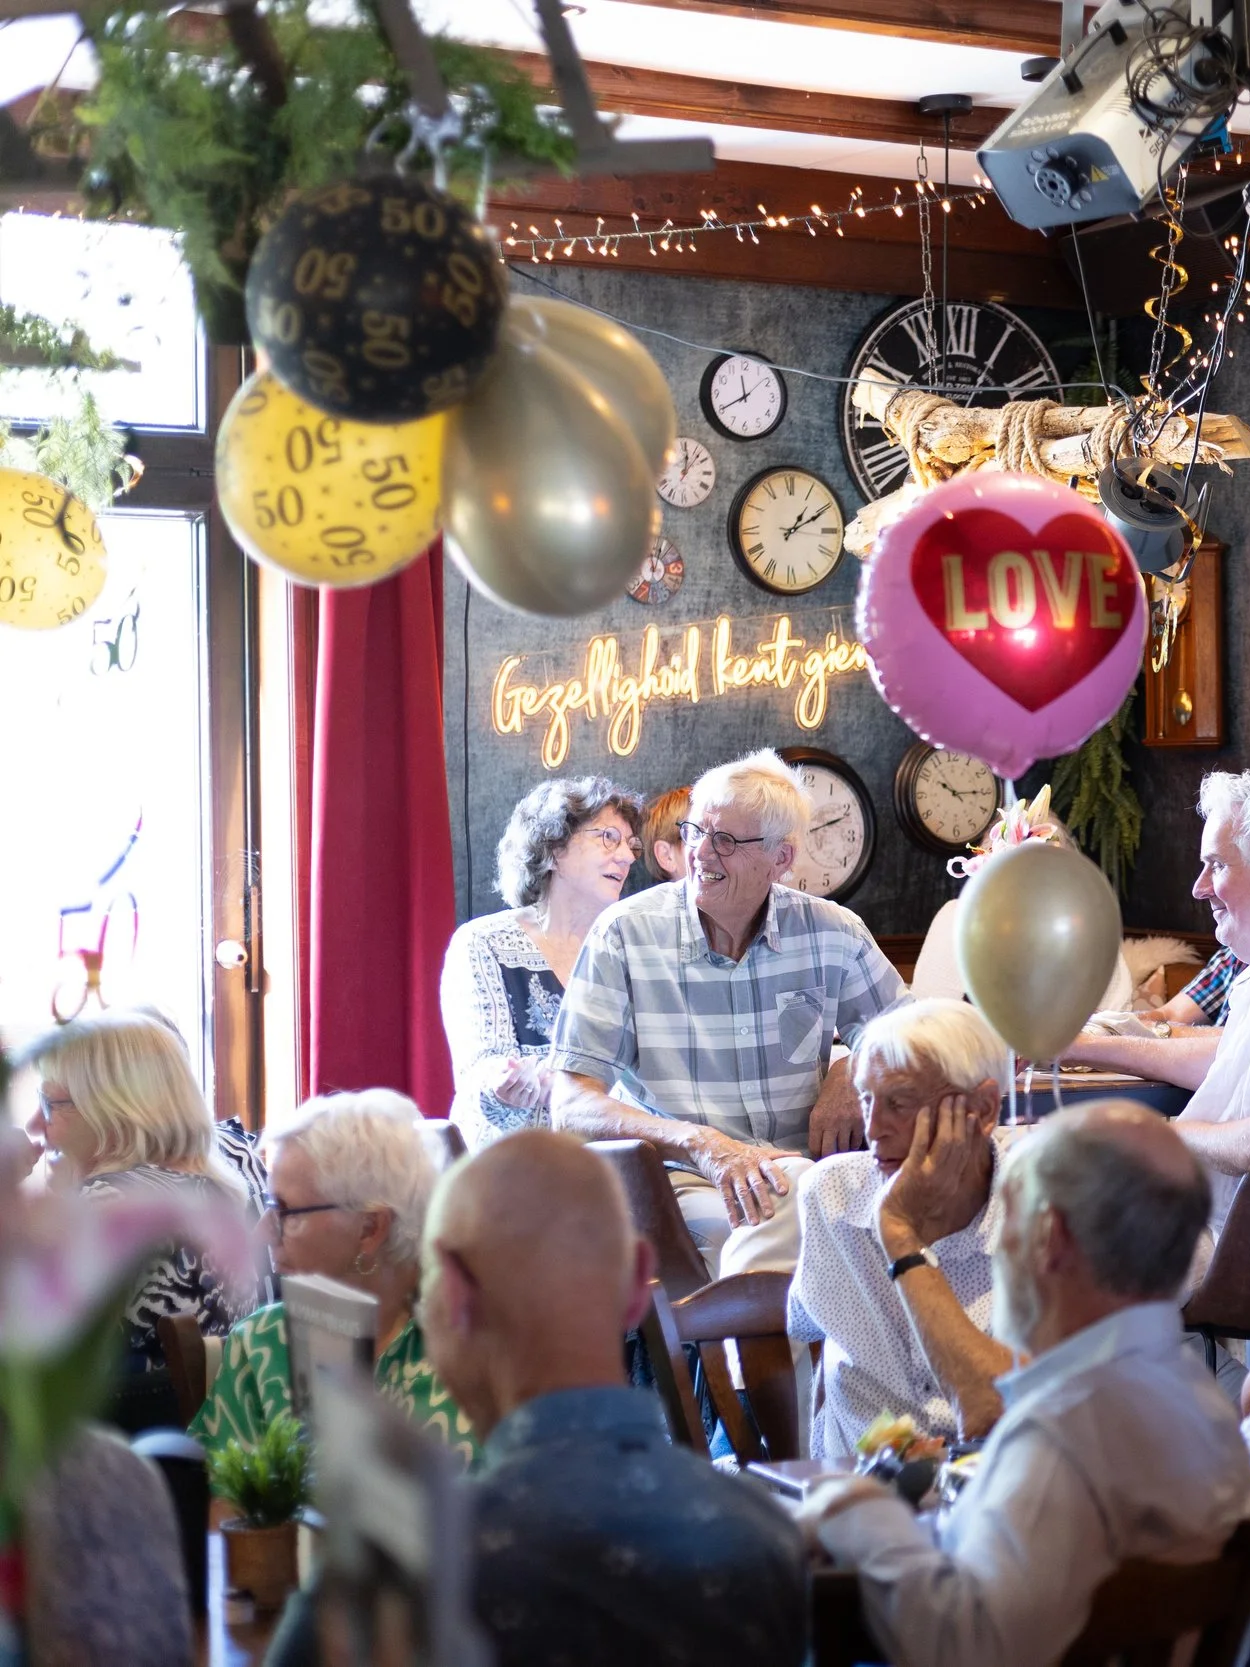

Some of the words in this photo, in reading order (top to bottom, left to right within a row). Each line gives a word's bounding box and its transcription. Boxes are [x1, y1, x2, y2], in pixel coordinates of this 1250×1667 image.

[381, 198, 445, 239] 50
[294, 249, 356, 298] 50
[442, 253, 482, 328] 50
[362, 310, 409, 369] 50
[945, 304, 981, 359] XII
[286, 417, 342, 474] 50
[22, 491, 57, 528] 50
[253, 485, 304, 530] 50
[362, 455, 417, 510] 50
[56, 531, 86, 576] 50
[320, 526, 376, 568] 50
[57, 596, 86, 626] 50
[941, 550, 1122, 631] LOVE
[91, 614, 138, 676] 50
[713, 614, 801, 693] kent
